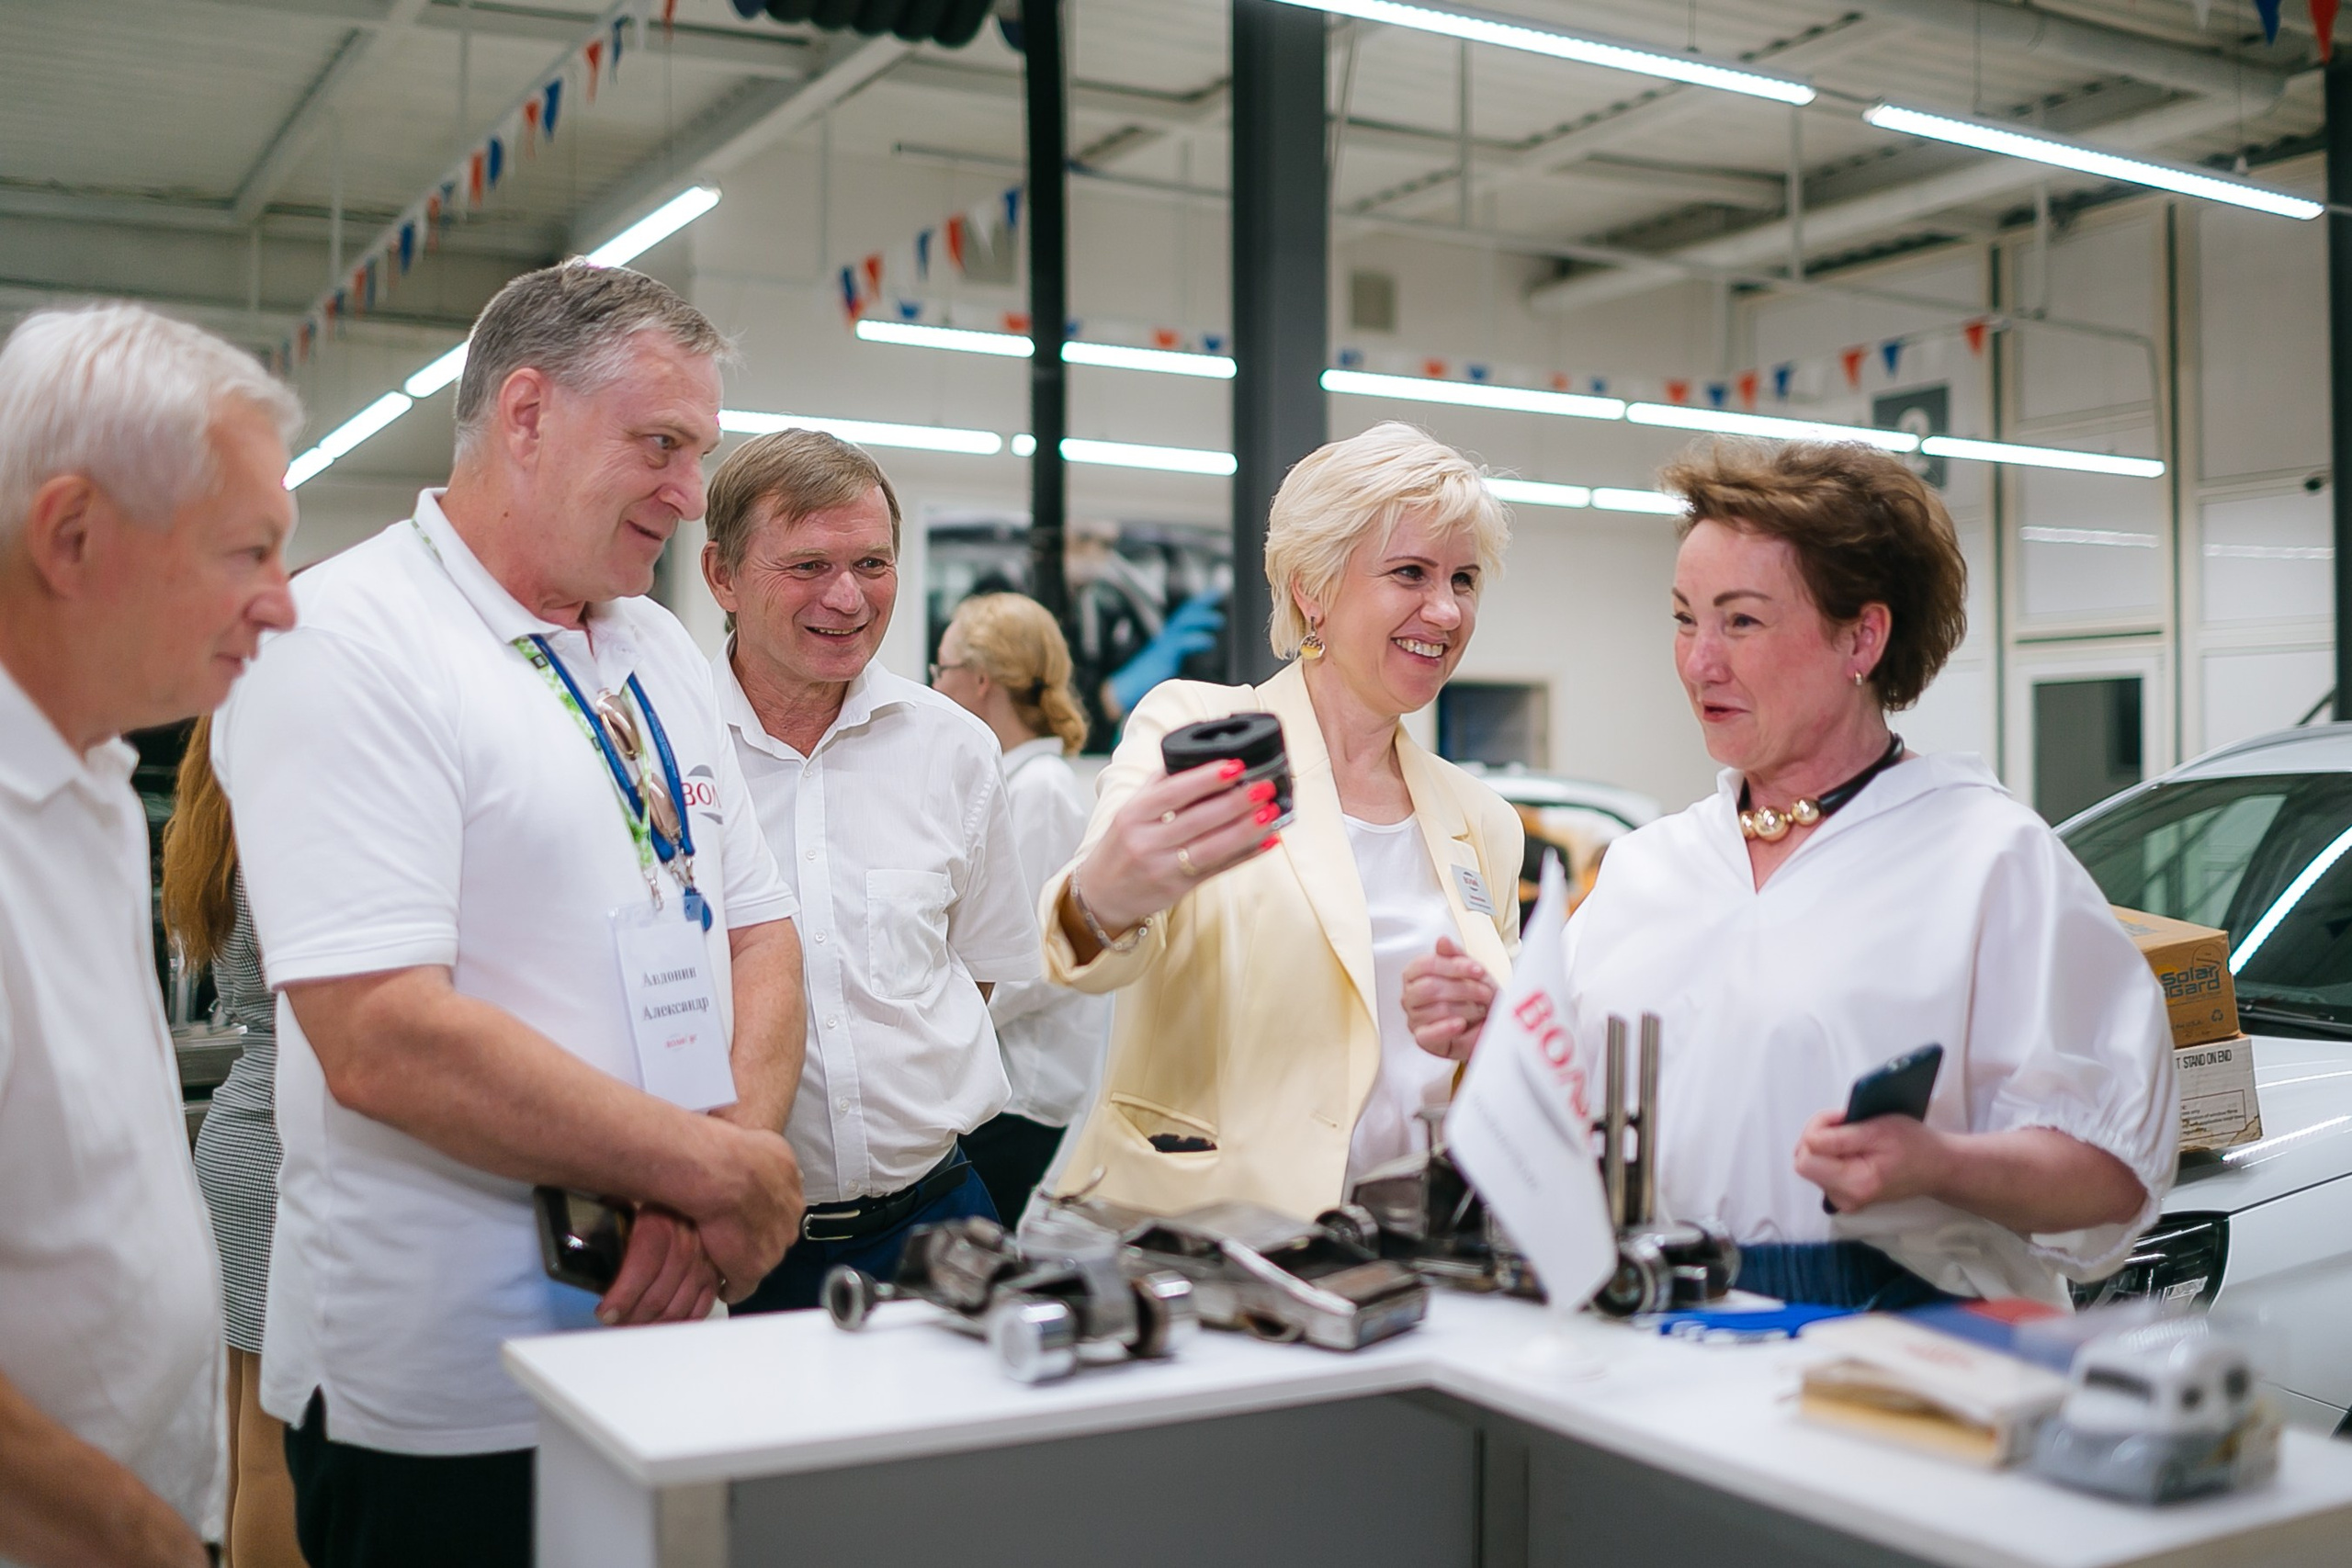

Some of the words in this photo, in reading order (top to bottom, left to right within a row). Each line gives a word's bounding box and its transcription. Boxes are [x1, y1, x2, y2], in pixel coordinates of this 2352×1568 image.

[642, 966, 697, 987] Авдонин
[2160, 966, 2217, 986] Solar
[2169, 970, 2220, 998] Gard
[643, 996, 710, 1022] Александр
[2183, 1054, 2206, 1069] STAND
[2207, 1052, 2217, 1065] ON
[2217, 1049, 2233, 1063] END
